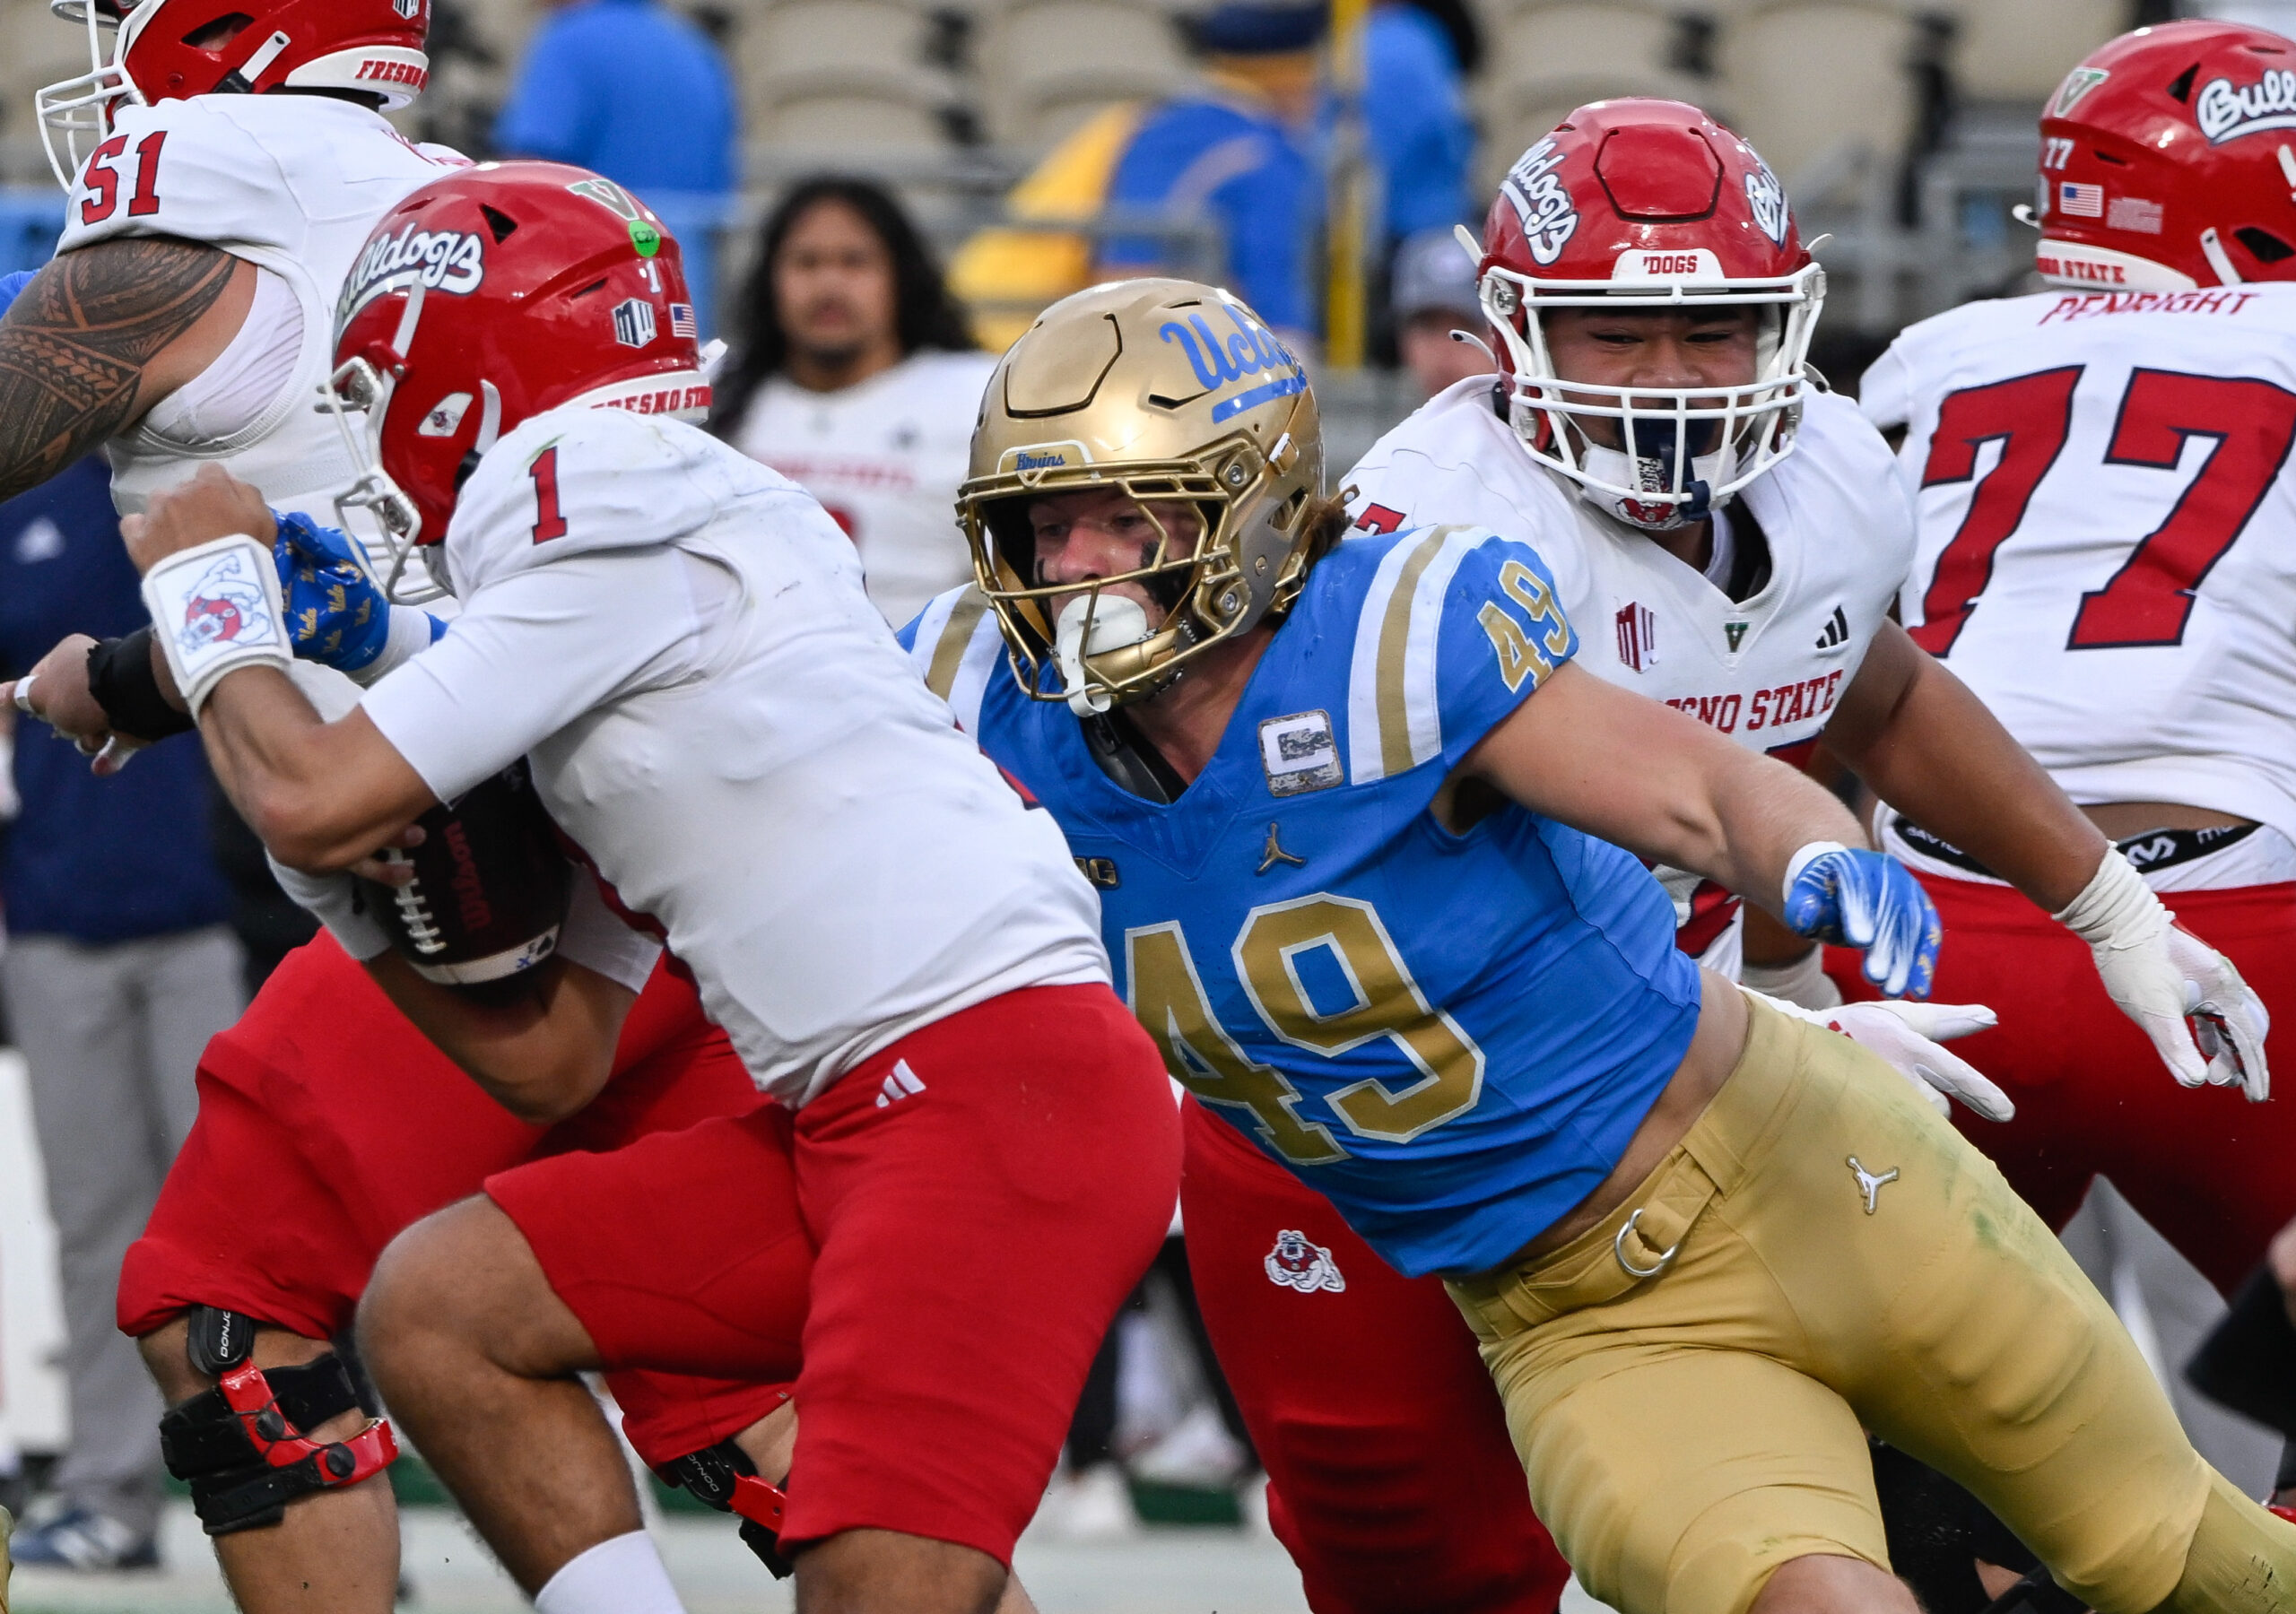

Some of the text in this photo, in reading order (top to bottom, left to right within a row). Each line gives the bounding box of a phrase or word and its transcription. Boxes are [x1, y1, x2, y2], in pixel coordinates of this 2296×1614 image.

[82, 131, 168, 225] 51
[2044, 137, 2074, 170] 77
[2065, 260, 2125, 283] STATE
[2037, 292, 2261, 326] PENRIGHT
[591, 389, 681, 414] ESNO
[1014, 451, 1065, 471] Bruins
[529, 445, 568, 545] 1
[1905, 364, 2296, 659] 77
[1476, 560, 1570, 693] 49
[1746, 669, 1845, 731] STATE
[1261, 715, 1334, 776] C
[1124, 891, 1487, 1167] 49
